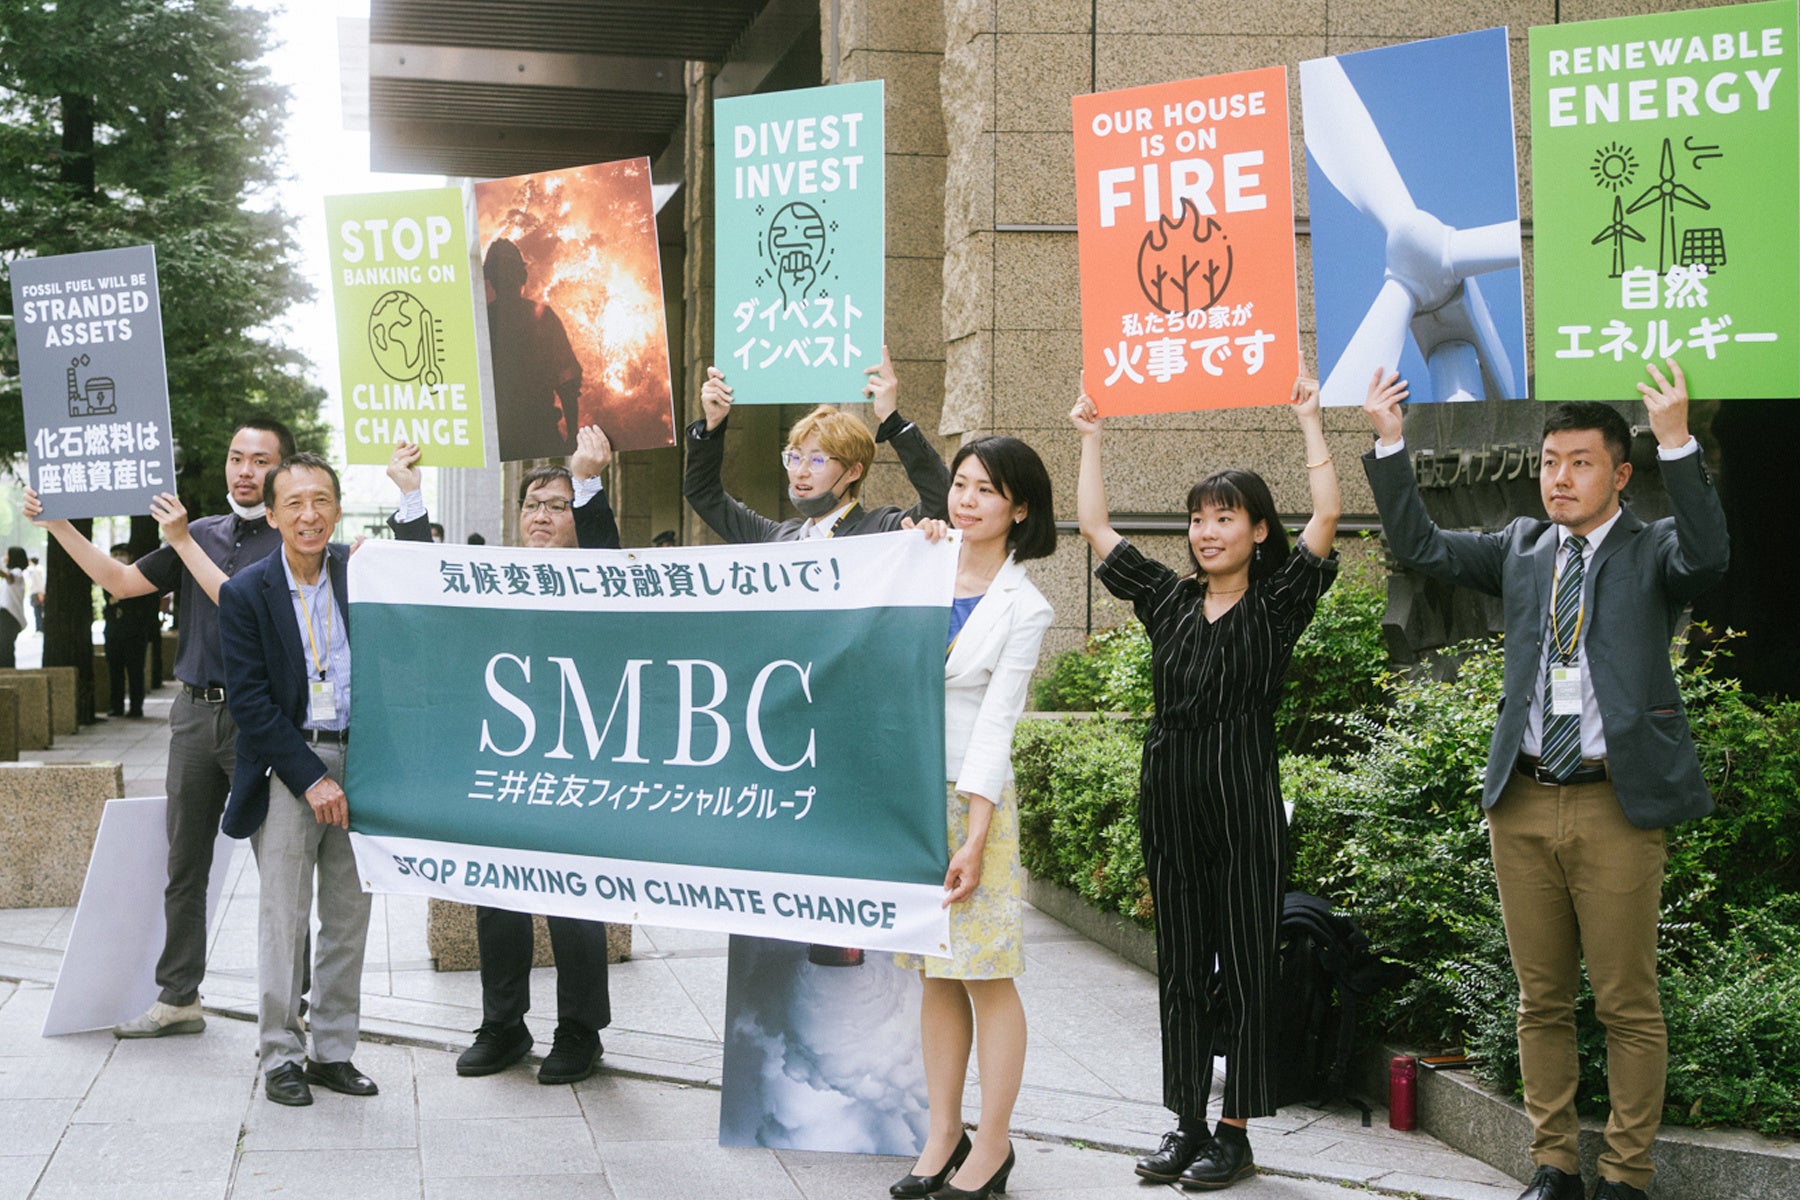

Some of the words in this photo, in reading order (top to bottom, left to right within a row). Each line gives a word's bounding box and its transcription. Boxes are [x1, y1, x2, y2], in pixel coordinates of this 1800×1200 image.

[1549, 28, 1783, 76] RENEWABLE
[1092, 107, 1152, 136] OUR
[1164, 91, 1266, 127] HOUSE
[1549, 68, 1782, 127] ENERGY
[734, 113, 863, 158] DIVEST
[1140, 134, 1165, 157] IS
[1175, 128, 1216, 153] ON
[735, 155, 864, 199] INVEST
[1098, 150, 1267, 228] FIRE
[341, 216, 452, 263] STOP
[22, 283, 62, 298] FOSSIL
[66, 279, 95, 292] FUEL
[98, 275, 127, 290] WILL
[131, 274, 147, 286] BE
[343, 266, 422, 287] BANKING
[428, 264, 456, 283] ON
[1621, 264, 1709, 310] 自然
[23, 290, 149, 324] STRANDED
[734, 294, 862, 332] ダイベスト
[1121, 302, 1254, 337] 私たちの家が
[45, 319, 132, 347] ASSETS
[734, 333, 862, 370] インベスト
[1555, 314, 1778, 361] エネルギー
[1103, 329, 1275, 387] 火事です
[352, 384, 467, 411] CLIMATE
[34, 422, 160, 459] 化石燃料は
[355, 418, 469, 445] CHANGE
[38, 459, 162, 495] 座礁資産に
[478, 653, 815, 771] SMBC
[468, 769, 816, 820] 三井住友フィナンシャルグループ
[392, 855, 456, 883] STOP
[465, 861, 587, 897] BANKING
[595, 875, 635, 902] ON
[645, 880, 765, 915] CLIMATE
[774, 893, 897, 930] CHANGE
